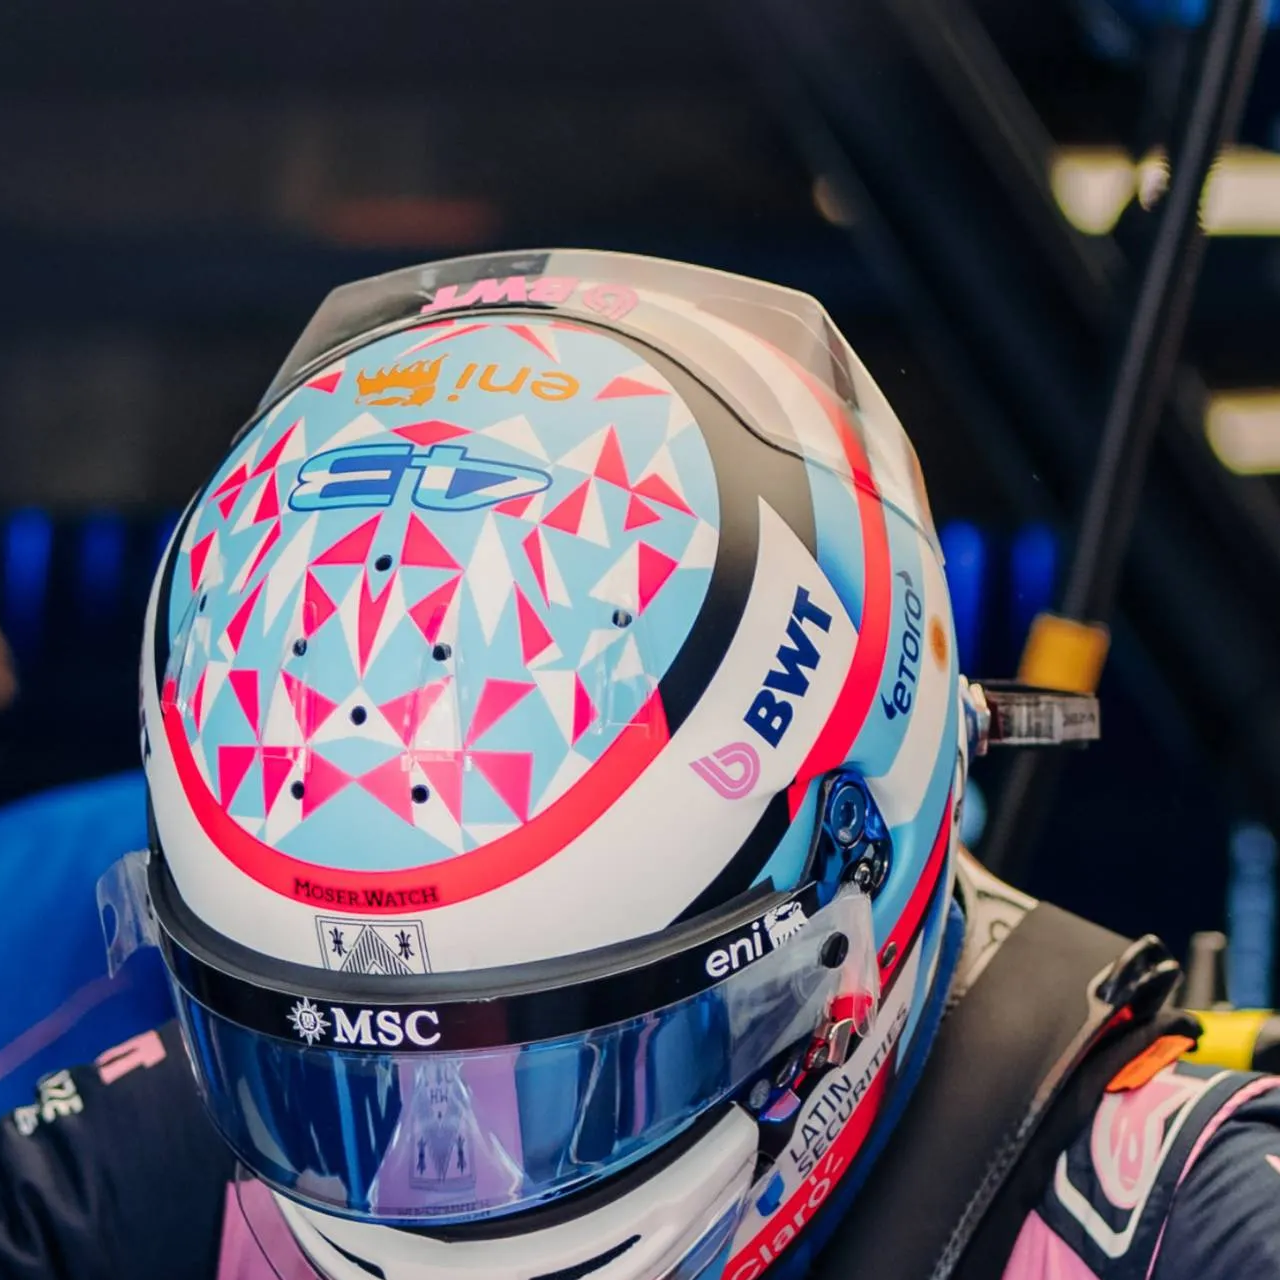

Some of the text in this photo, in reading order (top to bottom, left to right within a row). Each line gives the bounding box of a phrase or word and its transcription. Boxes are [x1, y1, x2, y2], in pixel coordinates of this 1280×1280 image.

[421, 275, 581, 314] BWT
[446, 362, 581, 403] eni
[287, 442, 553, 512] 43
[743, 584, 833, 750] BWT
[293, 877, 440, 909] MOSER WATCH
[705, 925, 765, 978] eni
[329, 1006, 442, 1047] MSC
[797, 1002, 910, 1180] SECURITIES
[789, 1073, 852, 1163] LATIN
